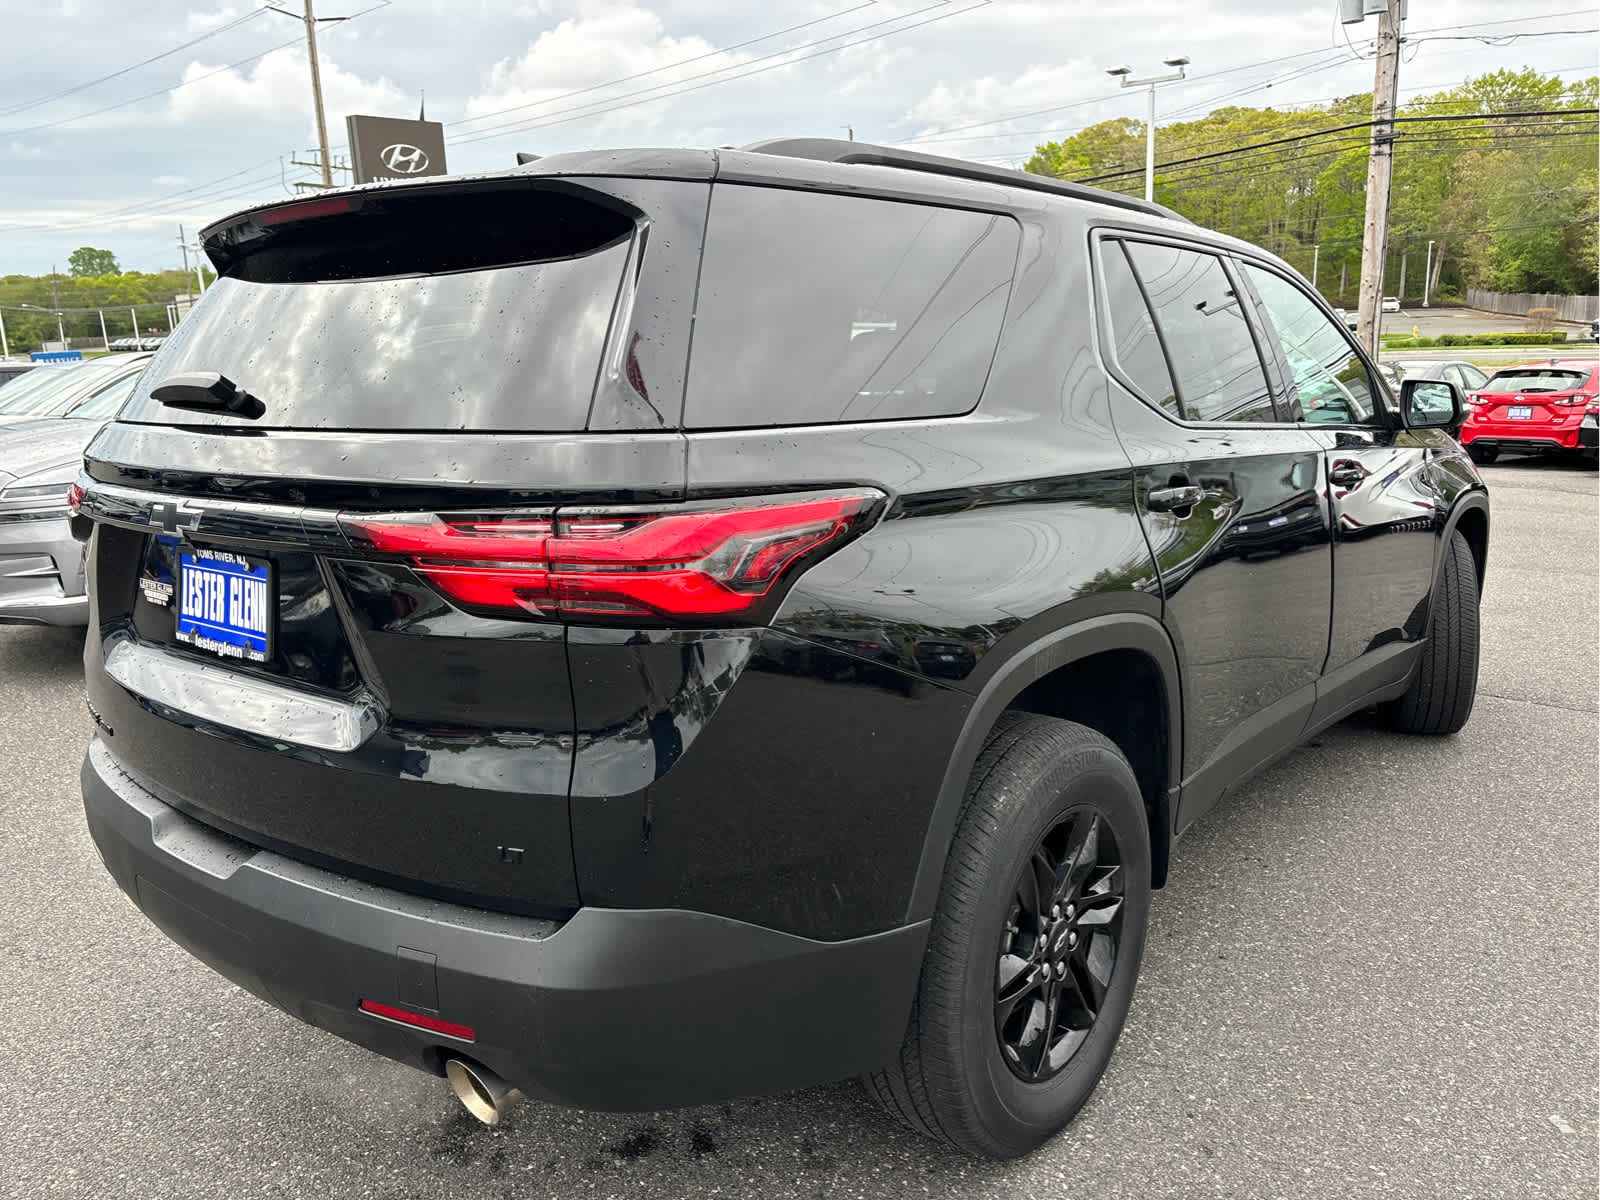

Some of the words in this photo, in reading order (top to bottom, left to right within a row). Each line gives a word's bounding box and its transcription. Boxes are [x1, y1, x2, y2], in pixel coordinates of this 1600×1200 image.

[196, 549, 213, 560] TOMS
[182, 568, 225, 623] LESTER
[229, 577, 267, 634] GLENN
